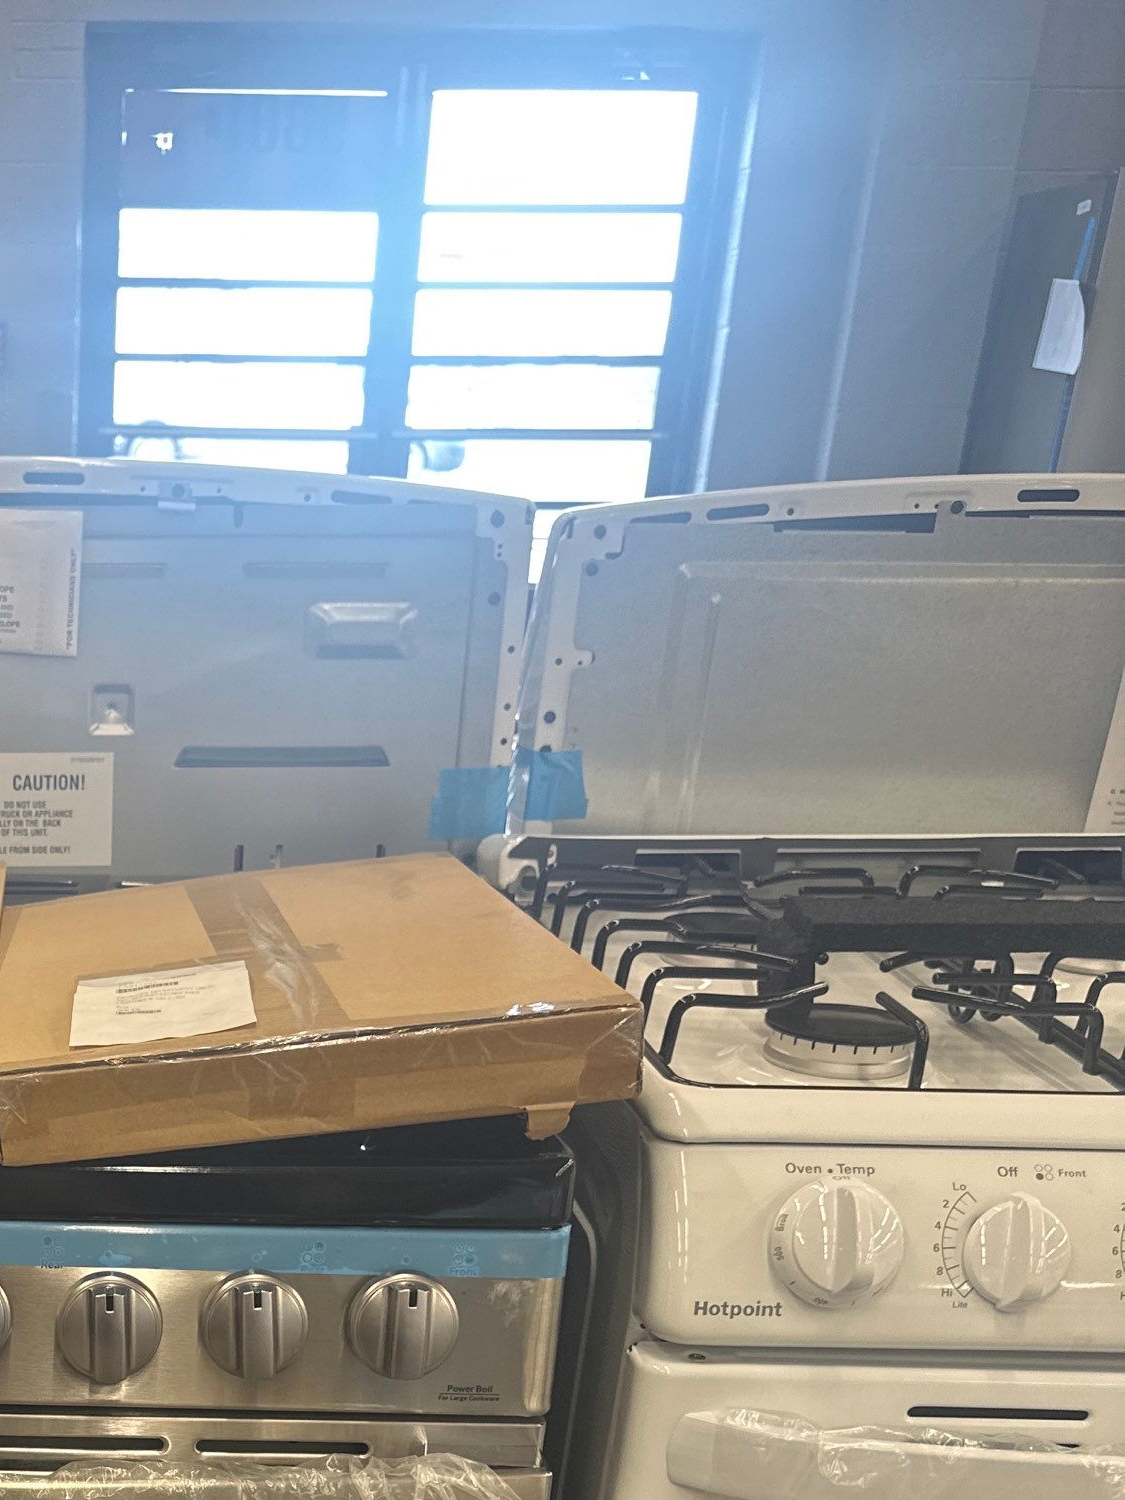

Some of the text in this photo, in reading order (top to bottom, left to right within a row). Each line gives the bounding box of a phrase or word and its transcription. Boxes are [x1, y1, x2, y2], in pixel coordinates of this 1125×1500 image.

[67, 576, 76, 628] TECHNICIANS
[13, 774, 85, 791] CAUTION!
[4, 801, 46, 809] DO NOT USE
[22, 810, 32, 818] OR
[34, 810, 73, 818] APPLIANCE
[13, 819, 23, 827] ON
[26, 819, 38, 827] THE
[43, 819, 61, 827] BACK
[9, 846, 30, 854] FROM
[32, 846, 47, 854] SIDE
[50, 846, 71, 854] ONLY!
[785, 1162, 875, 1176] Oven Temp
[998, 1167, 1018, 1177] Off
[1058, 1169, 1086, 1178] Front
[952, 1182, 967, 1191] Lo
[942, 1200, 949, 1208] 2
[934, 1222, 941, 1230] 4
[1113, 1224, 1120, 1232] 4
[933, 1243, 939, 1251] 6
[1112, 1247, 1119, 1255] 6
[936, 1267, 943, 1275] 8
[1116, 1270, 1122, 1278] 8
[941, 1288, 953, 1297] Hi
[693, 1300, 782, 1320] Hotpoint
[447, 1384, 493, 1393] Power Boil
